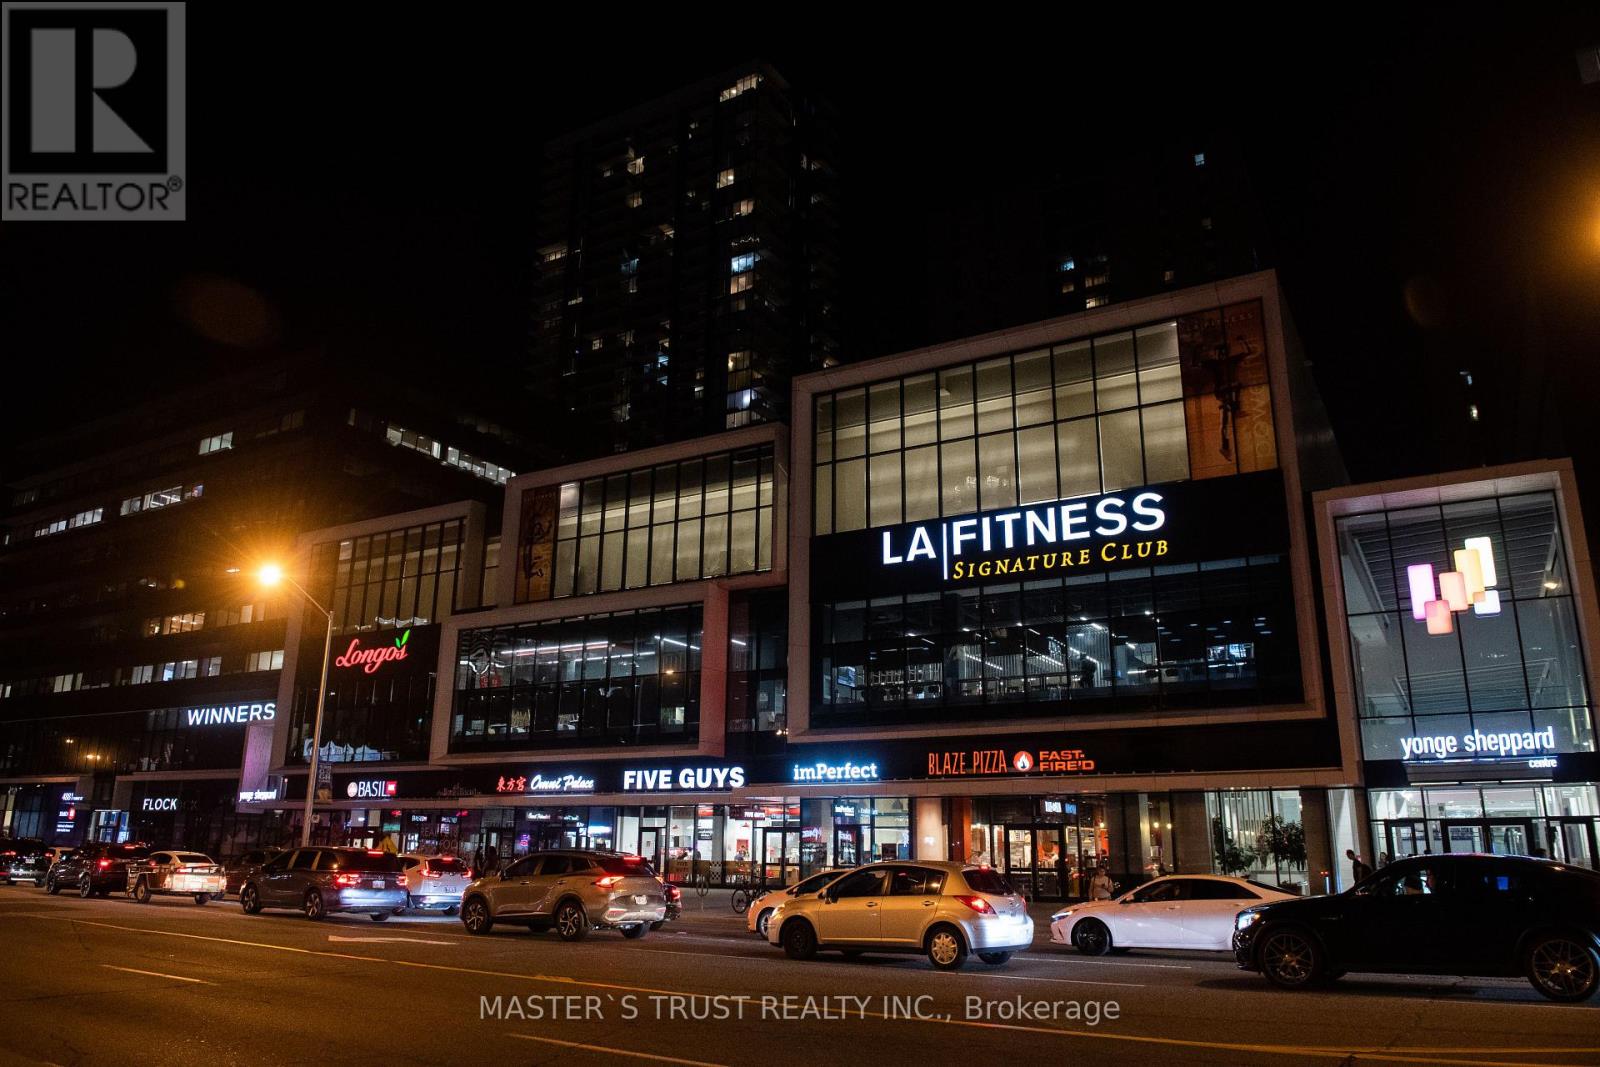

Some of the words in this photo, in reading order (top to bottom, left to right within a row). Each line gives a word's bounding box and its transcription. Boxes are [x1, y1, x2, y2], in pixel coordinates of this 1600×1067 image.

[882, 526, 937, 565] LA
[951, 492, 1166, 556] FITNESS
[953, 549, 1090, 580] SIGNATURE
[1100, 539, 1169, 562] CLUB
[187, 703, 276, 727] WINNERS
[1400, 734, 1458, 760] yonge
[1463, 725, 1556, 757] sheppard
[793, 762, 878, 780] imPerfect
[928, 752, 966, 775] BLAZE
[973, 749, 1008, 774] PIZZA
[1039, 760, 1095, 772] FIRE'D
[1528, 758, 1558, 769] centre
[530, 774, 562, 790] Omni
[562, 774, 594, 791] Palace
[623, 769, 672, 790] FIVE
[678, 767, 745, 788] GUYS
[358, 781, 390, 797] BASIL
[143, 798, 177, 811] FLOCK
